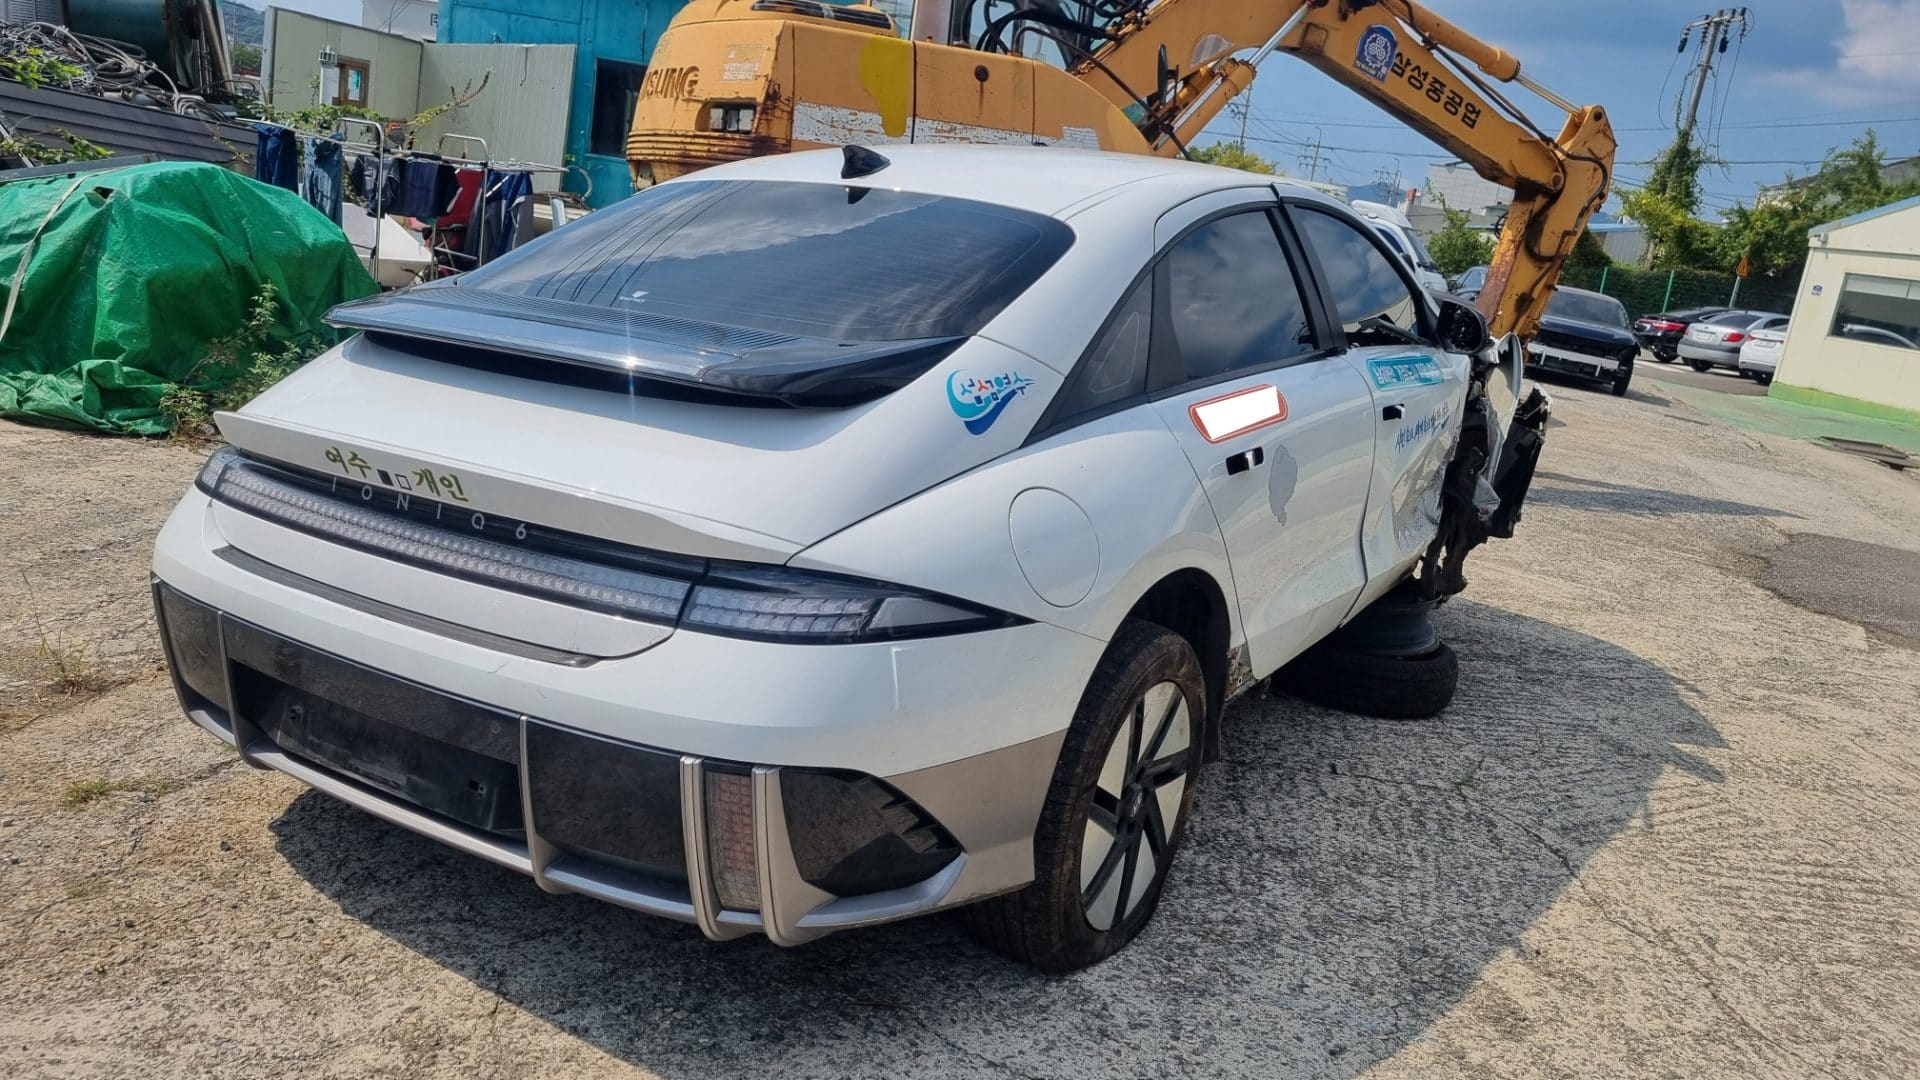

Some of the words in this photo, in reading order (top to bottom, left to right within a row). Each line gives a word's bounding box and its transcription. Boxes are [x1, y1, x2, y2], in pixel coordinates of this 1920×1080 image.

[1390, 51, 1481, 130] 삼성중공업
[325, 446, 372, 478] 여수
[412, 468, 470, 502] 개인
[515, 523, 528, 540] 6
